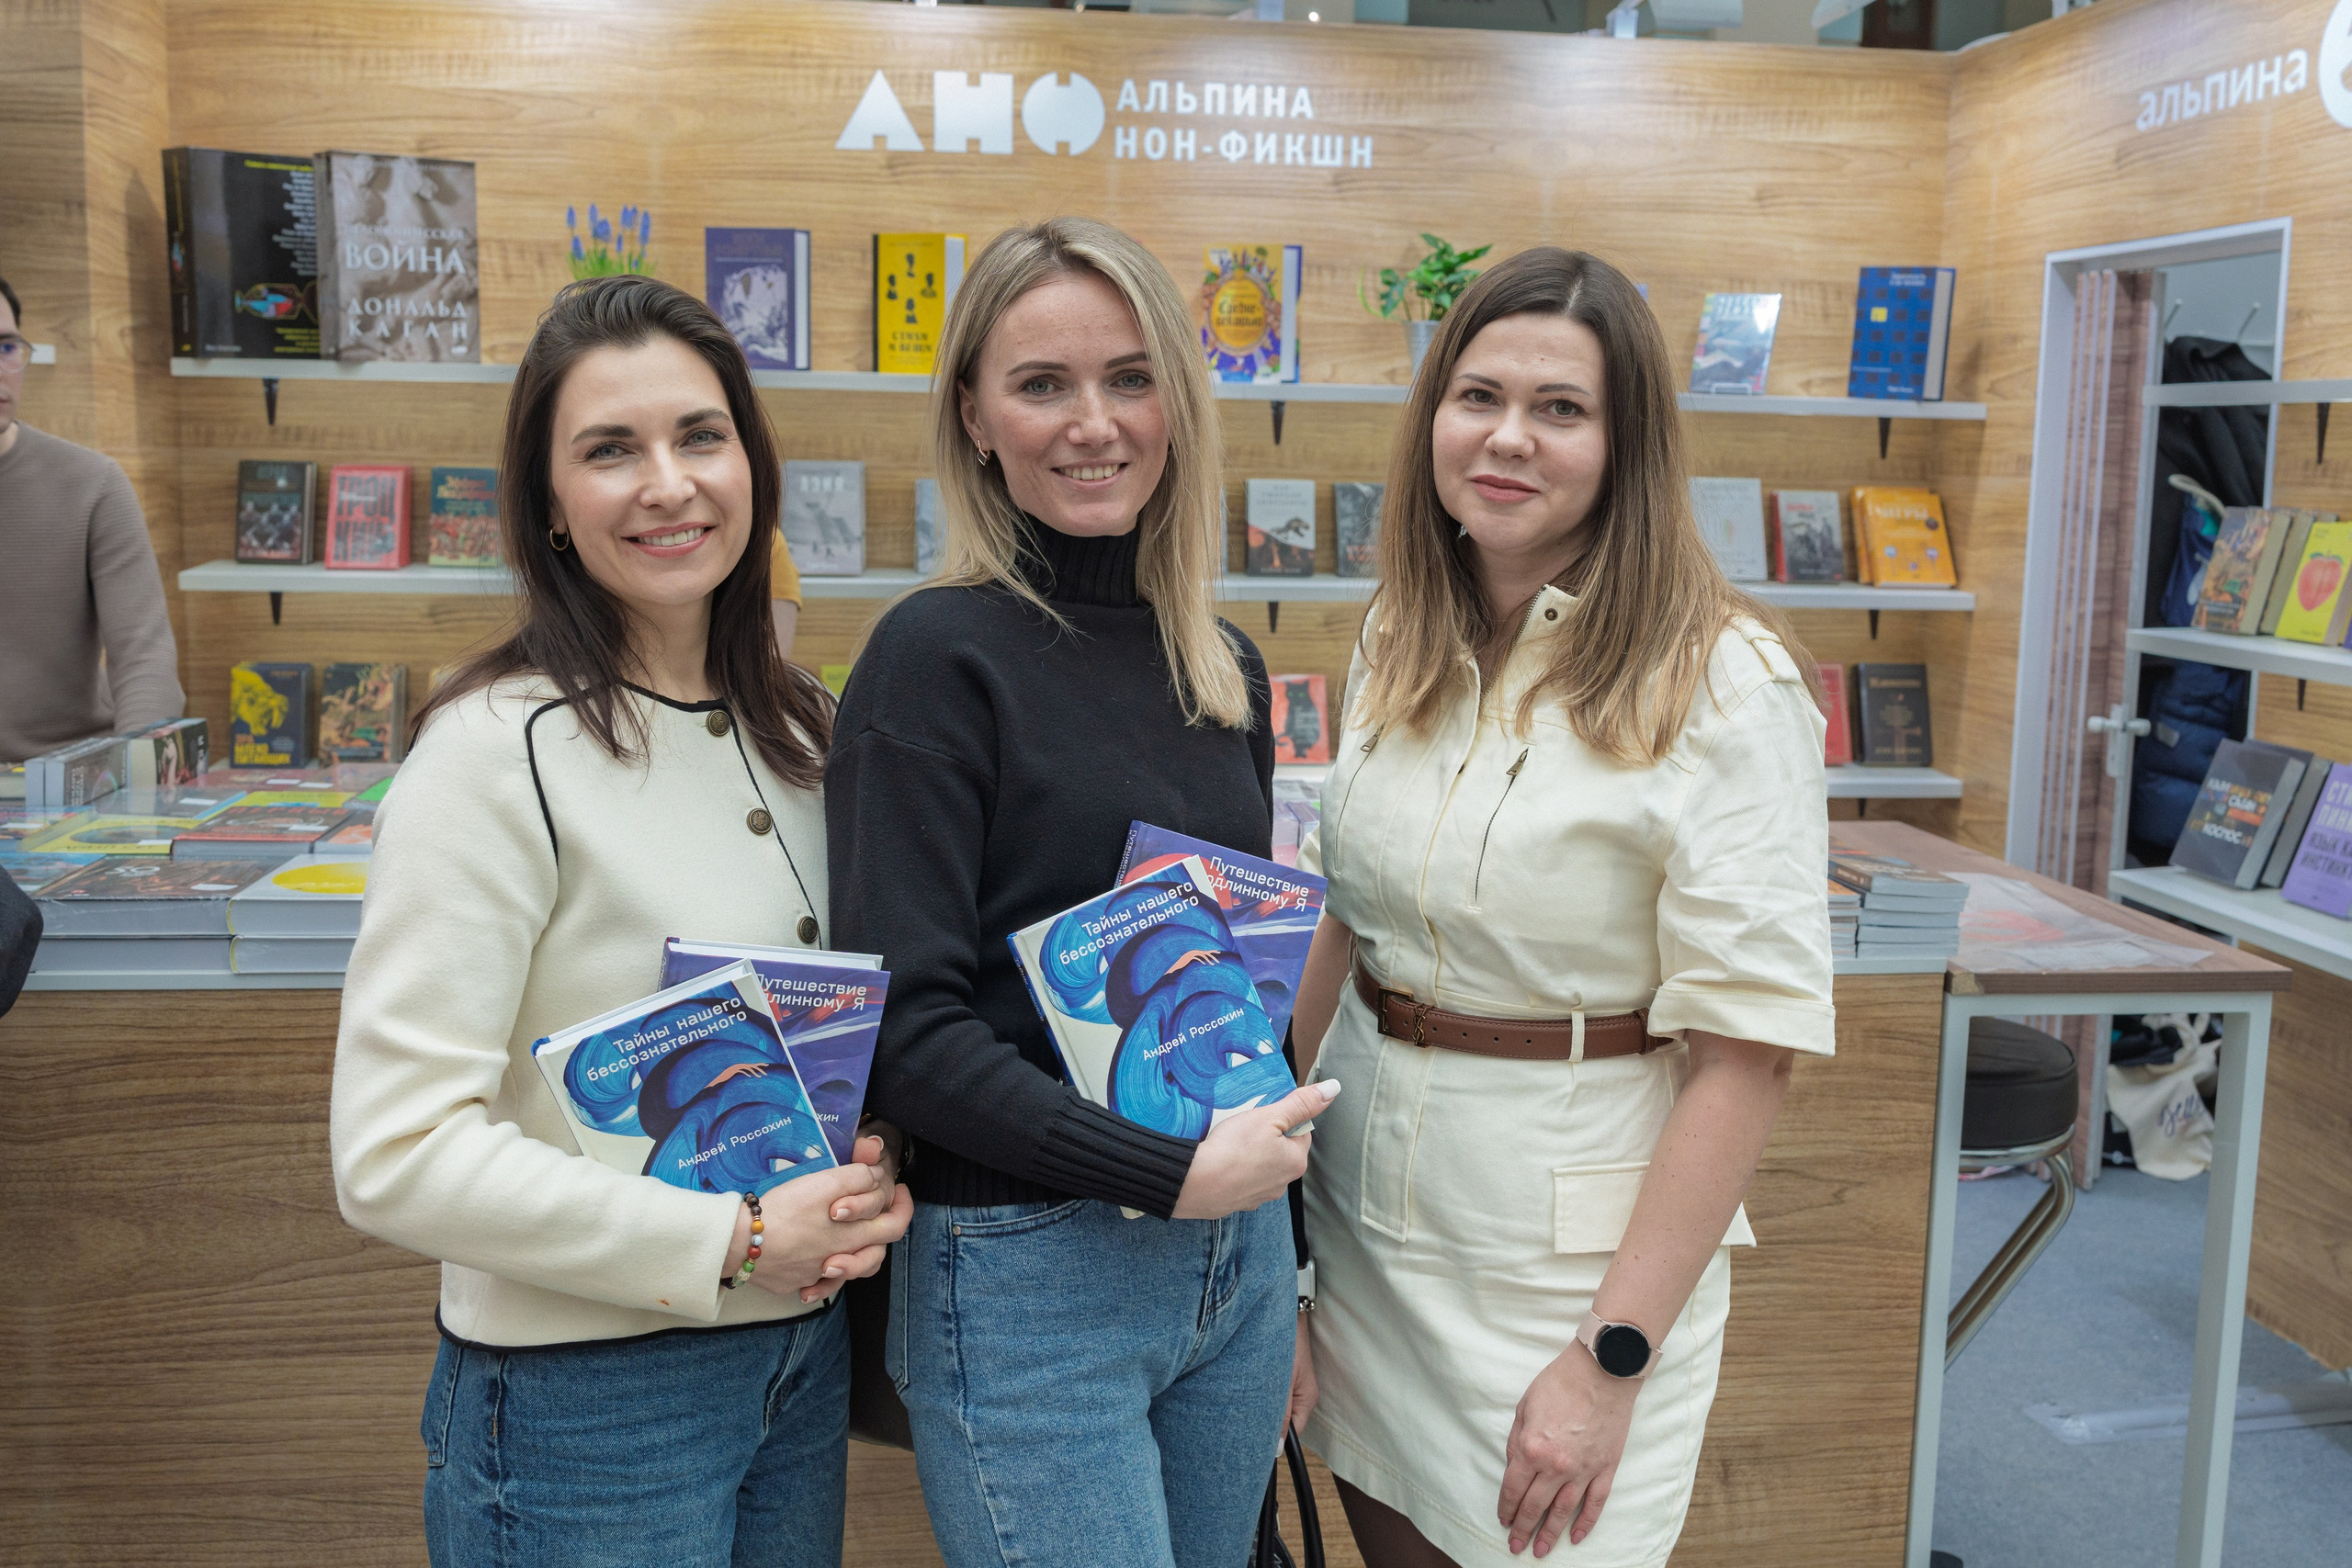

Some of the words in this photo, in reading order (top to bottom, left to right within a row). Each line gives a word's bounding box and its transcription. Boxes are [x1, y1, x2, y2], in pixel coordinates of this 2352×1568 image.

[1115, 78, 1315, 119] АЛЬПИНА
[2135, 48, 2309, 131] альпина
[1114, 125, 1374, 169] НОН-ФИКШН
[345, 240, 467, 274] ВОЙНА
[346, 297, 469, 318] ДОНАЛЬД
[348, 320, 469, 340] КАГАН
[1206, 874, 1289, 909] одлинному
[1296, 897, 1306, 911] Я
[1209, 856, 1309, 897] Путешествие
[1059, 895, 1199, 965] бессознательного
[1081, 908, 1132, 938] Тайны
[1137, 880, 1193, 913] нашего
[756, 974, 866, 996] Путешествие
[853, 998, 865, 1010] Я
[587, 1010, 747, 1081] бессознательного
[613, 1025, 670, 1054] Тайны
[676, 996, 741, 1031] нашего
[1143, 1033, 1187, 1061] Андрей
[1189, 1008, 1245, 1039] Россохин
[678, 1142, 727, 1169] Андрей
[730, 1115, 792, 1147] Россохин
